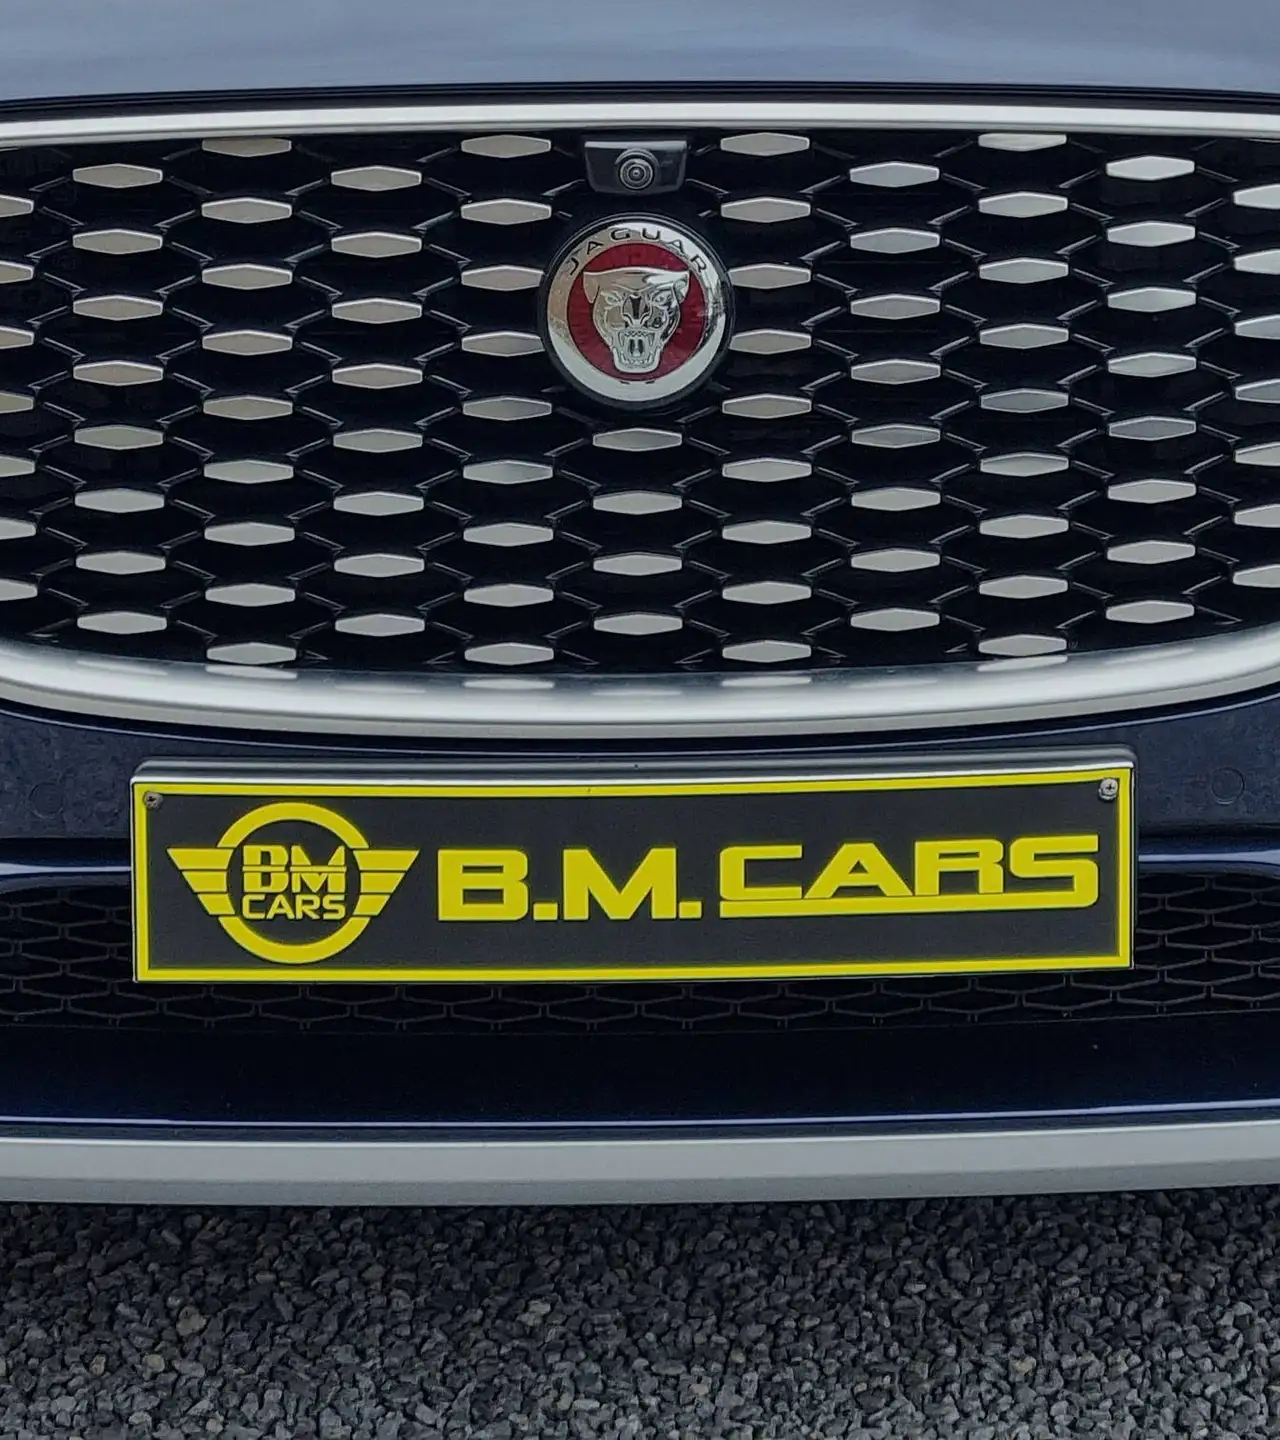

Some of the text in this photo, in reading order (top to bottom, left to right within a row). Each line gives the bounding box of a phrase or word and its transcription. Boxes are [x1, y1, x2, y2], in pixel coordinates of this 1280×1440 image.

[568, 226, 708, 277] JAGUAR
[242, 844, 347, 893] BM
[437, 834, 1099, 921] B.M. CARS
[242, 893, 347, 920] CARS
